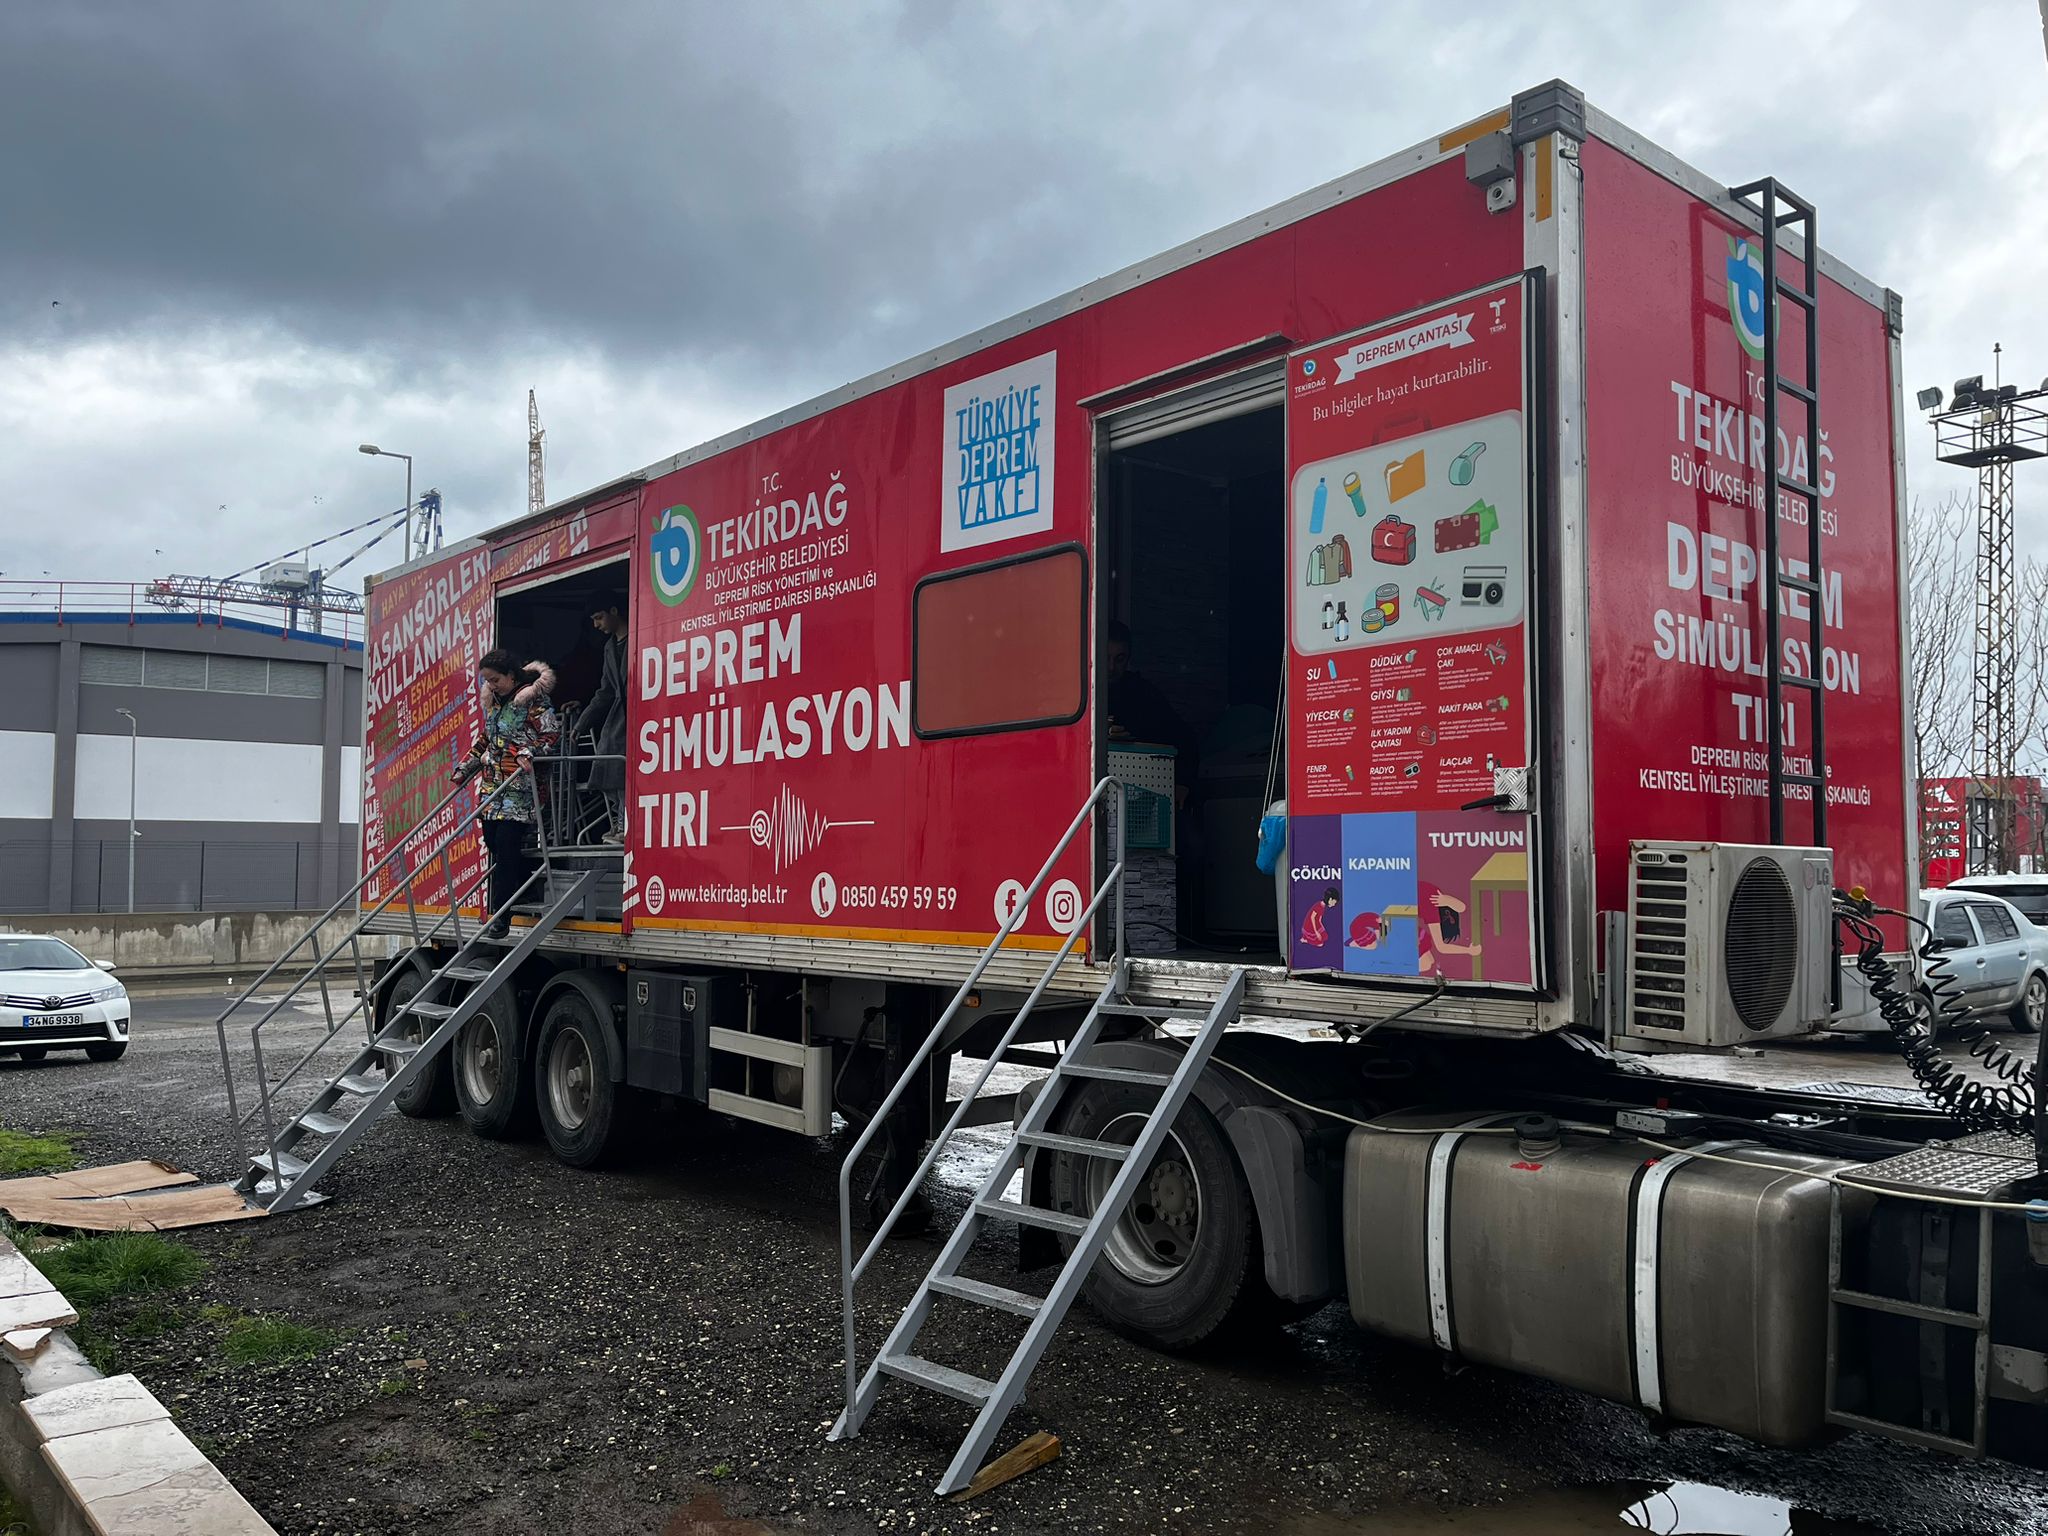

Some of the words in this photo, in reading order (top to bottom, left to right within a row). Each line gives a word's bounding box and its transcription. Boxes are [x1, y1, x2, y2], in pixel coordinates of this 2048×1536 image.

[1356, 338, 1406, 365] DEPREM
[1408, 319, 1463, 351] ÇANTASI
[1312, 406, 1329, 421] Bu
[1332, 394, 1373, 417] bilgiler
[1377, 382, 1409, 403] hayat
[1412, 358, 1492, 392] kurtarabilir.
[956, 384, 1041, 450] TÜRKİYE
[959, 427, 1040, 487] DEPREM
[762, 472, 783, 494] T.C.
[706, 470, 848, 562] TEKİRDAĞ
[705, 554, 777, 592] BÜYÜKŞEHİR
[780, 529, 849, 571] BELEDİYESİ
[713, 582, 750, 606] DEPREM
[751, 577, 774, 600] RİSK
[775, 569, 820, 593] YÖNETİMİ
[821, 569, 834, 581] ve
[680, 614, 718, 633] KENTSEL
[718, 598, 773, 627] İYİLEŞTİRME
[774, 588, 813, 613] DAİRESİ
[814, 571, 877, 604] BAŞKANLIĞI
[370, 606, 465, 715] KULLANMA
[641, 612, 801, 701] DEPREM
[1370, 653, 1403, 668] DÜDÜK
[1437, 647, 1453, 659] ÇOK
[1454, 643, 1483, 655] AMAÇLI
[1306, 667, 1321, 681] SU
[1437, 659, 1454, 671] ÇAKI
[1370, 686, 1395, 701] GİYSİ
[412, 684, 449, 729] SABİTLE
[1305, 709, 1341, 722] YİYECEK
[1438, 702, 1461, 714] NAKİT
[1462, 701, 1483, 712] PARA
[1370, 728, 1382, 737] İLK
[1383, 726, 1412, 736] YARDIM
[1370, 738, 1402, 750] ÇANTASI
[1306, 764, 1328, 774] FENER
[1440, 756, 1473, 768] İLAÇLAR
[1691, 745, 1741, 769] DEPREM
[1743, 747, 1769, 771] RİSK
[1369, 765, 1395, 775] RADYO
[1639, 768, 1697, 793] KENTSEL
[1699, 769, 1769, 800] İYİLEŞTİRME
[638, 790, 709, 849] TIRI
[448, 833, 477, 865] AZIRLA
[1428, 830, 1524, 848] TUTUNUN
[1291, 865, 1342, 882] ÇÖKÜN
[1348, 857, 1411, 871] KAPANIN
[1816, 867, 1830, 887] LG
[668, 883, 788, 909] www.tekirdag.bel.tr
[841, 885, 877, 908] 0850
[880, 886, 908, 909] 459
[913, 886, 933, 910] 59
[937, 886, 957, 911] 59
[29, 1017, 41, 1026] 34
[42, 1016, 54, 1025] NG
[56, 1016, 80, 1025] 9938
